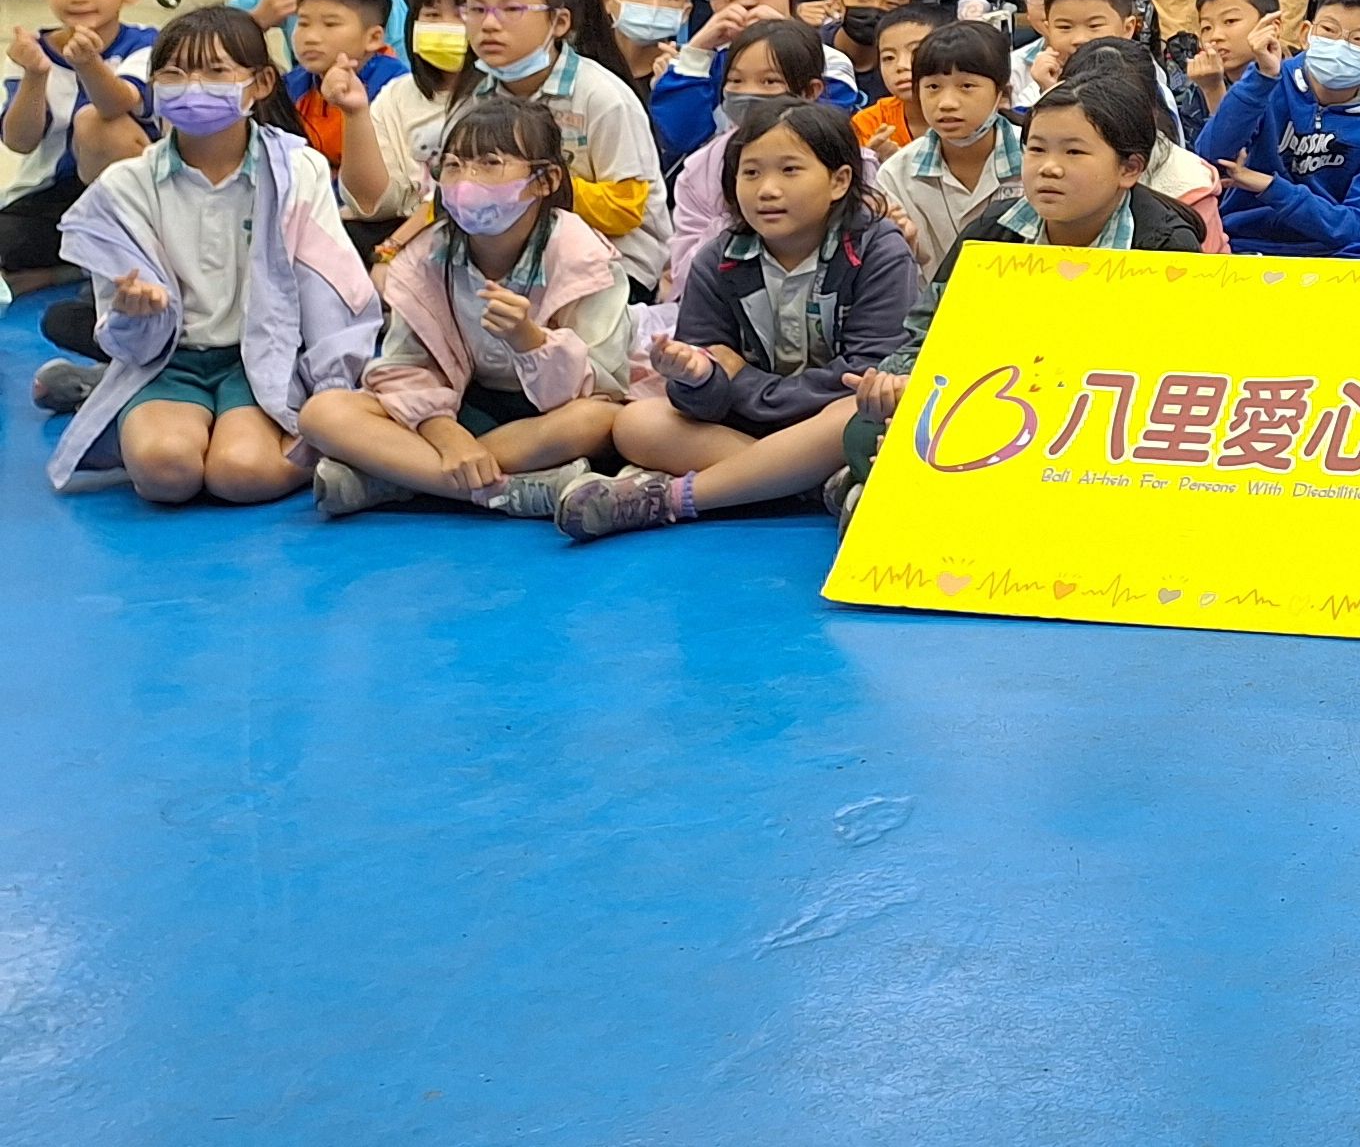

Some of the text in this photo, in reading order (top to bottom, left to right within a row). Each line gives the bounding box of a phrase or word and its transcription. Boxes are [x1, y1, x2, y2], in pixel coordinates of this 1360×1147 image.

[1041, 467, 1071, 483] Bali
[1140, 473, 1169, 490] For
[1178, 476, 1238, 494] Persons
